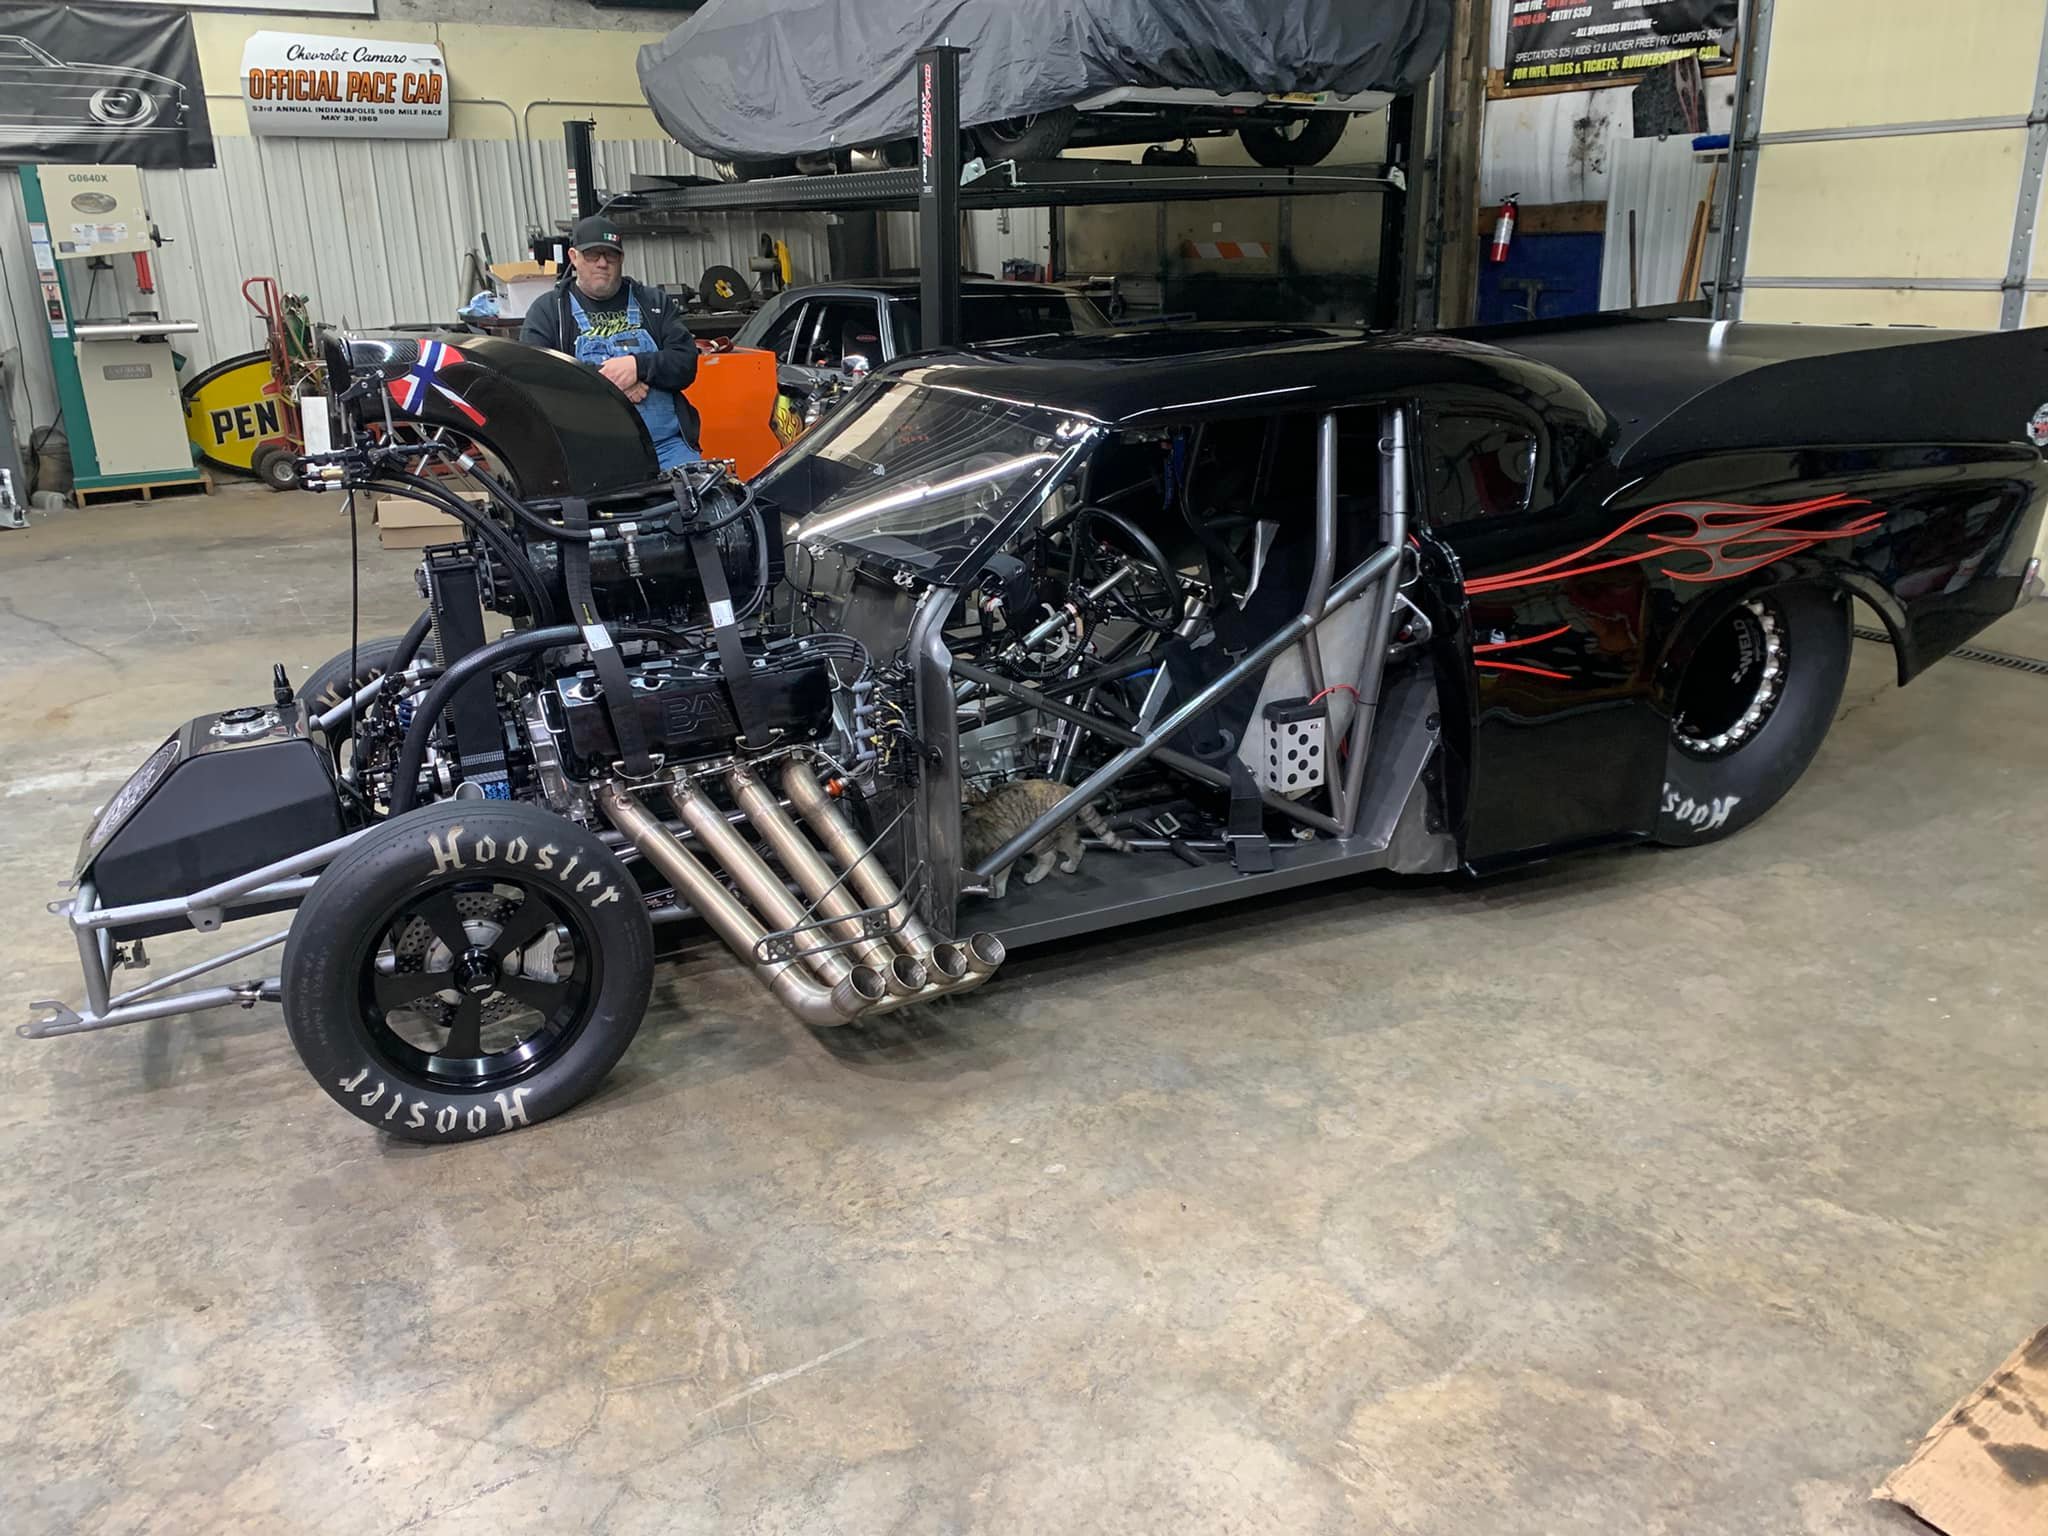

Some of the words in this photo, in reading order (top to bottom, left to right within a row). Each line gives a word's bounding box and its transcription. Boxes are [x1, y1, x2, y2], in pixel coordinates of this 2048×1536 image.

[1551, 9, 1573, 22] ENTRY
[1587, 22, 1620, 36] SPONSORS
[286, 44, 349, 62] Chevrolet
[353, 46, 408, 64] Camaro
[1515, 48, 1558, 63] SPECTATORS
[1574, 45, 1592, 57] KIDS
[1608, 39, 1634, 53] UNDER
[1634, 37, 1656, 50] FREE
[1660, 35, 1672, 47] RV
[1671, 31, 1707, 45] CAMPING
[1512, 67, 1528, 80] FOR
[1549, 62, 1574, 76] RULES
[1574, 63, 1582, 75] &
[1583, 57, 1620, 74] TICKETS:
[248, 67, 343, 102] OFFICIAL
[346, 71, 397, 104] PACE
[402, 72, 443, 105] CAR
[315, 106, 376, 115] INDIANAPOLIS
[398, 108, 418, 116] MILE
[421, 109, 443, 117] RACE
[68, 173, 109, 184] G0640X
[1733, 618, 1753, 672] WELD
[427, 825, 621, 908] Hoosier
[338, 1066, 534, 1134] Hoosier
